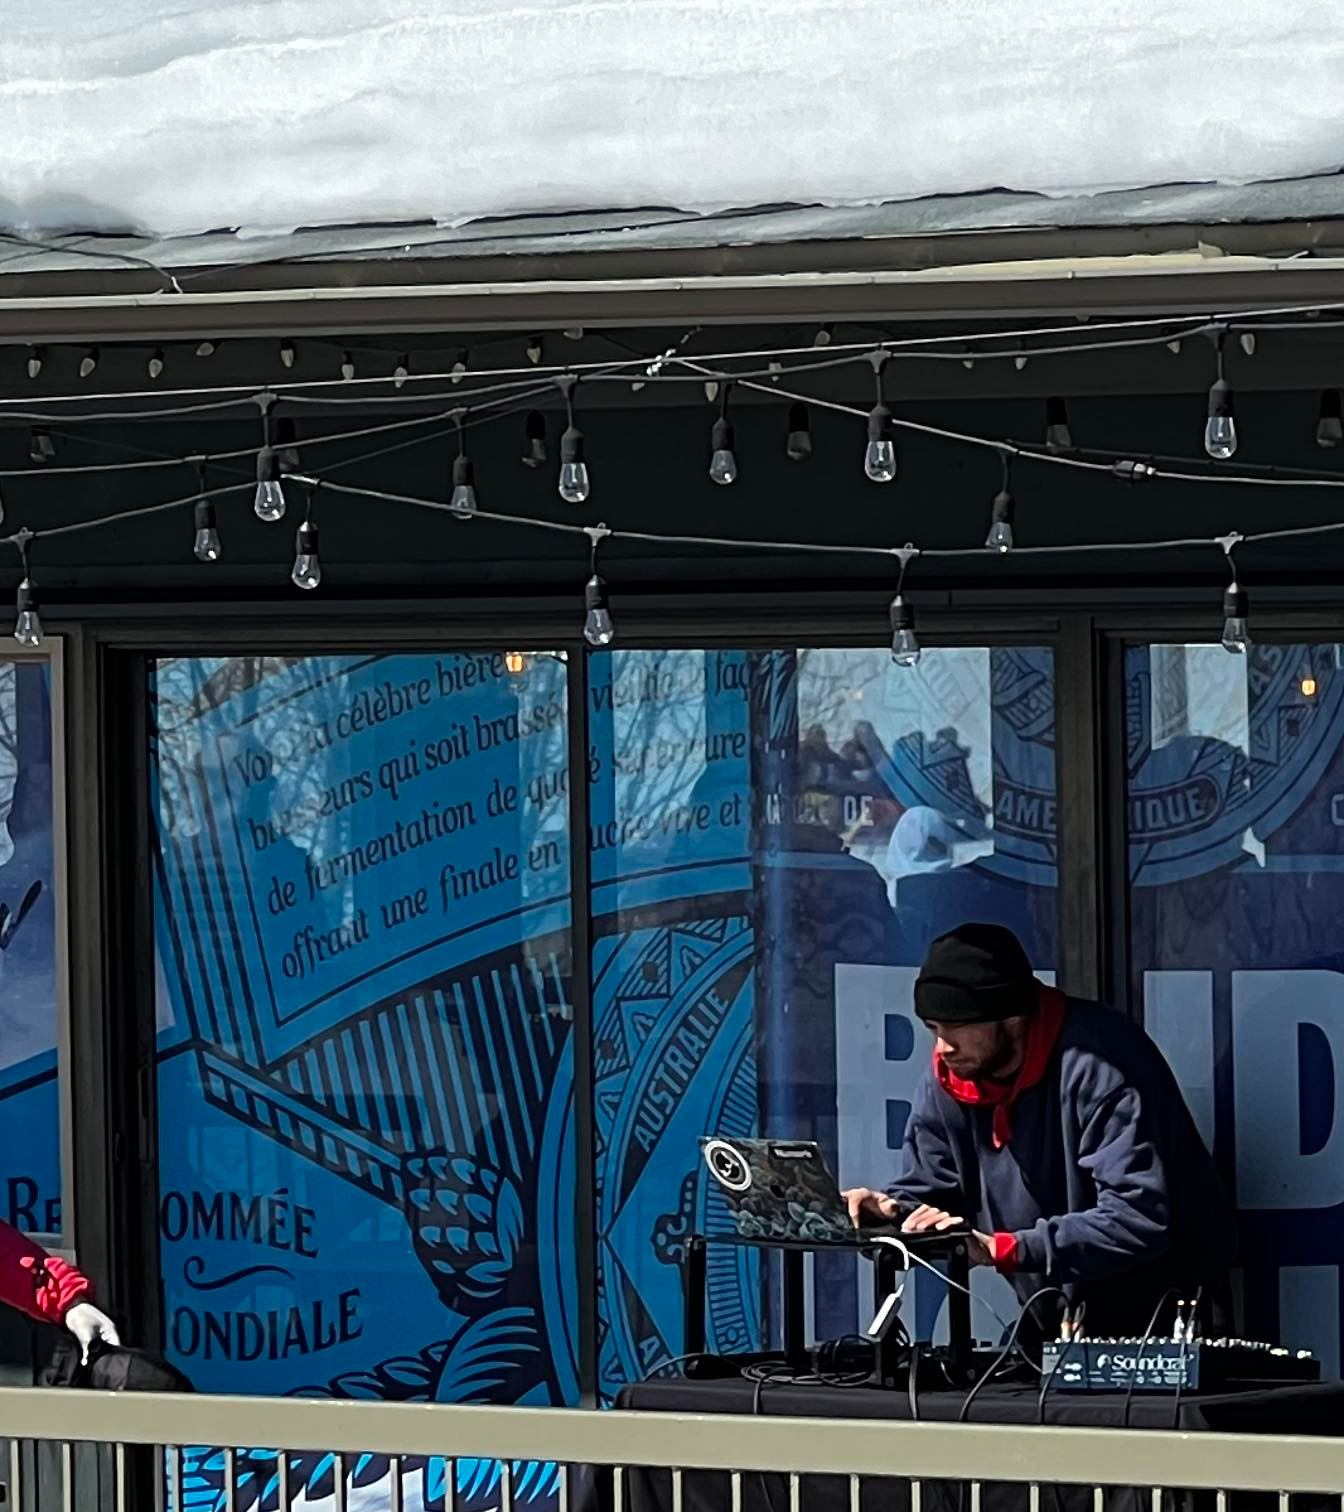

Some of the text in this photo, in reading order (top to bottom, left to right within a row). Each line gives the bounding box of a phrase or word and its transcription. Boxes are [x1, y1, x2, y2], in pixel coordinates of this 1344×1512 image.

[336, 677, 432, 739] célèbre
[435, 651, 504, 695] bière
[378, 738, 421, 800] qui
[424, 718, 470, 771] soit
[267, 875, 297, 915] de
[305, 802, 476, 894] fermentation
[486, 778, 518, 818] de
[719, 793, 742, 826] et
[843, 796, 874, 827] DE
[994, 790, 1056, 831] AME
[382, 888, 428, 929] une
[439, 846, 519, 914] finale
[527, 839, 561, 877] en
[633, 986, 730, 1154] AUSTRALIE
[161, 1188, 320, 1260] OMMÉE
[158, 1289, 364, 1362] ONDIALE
